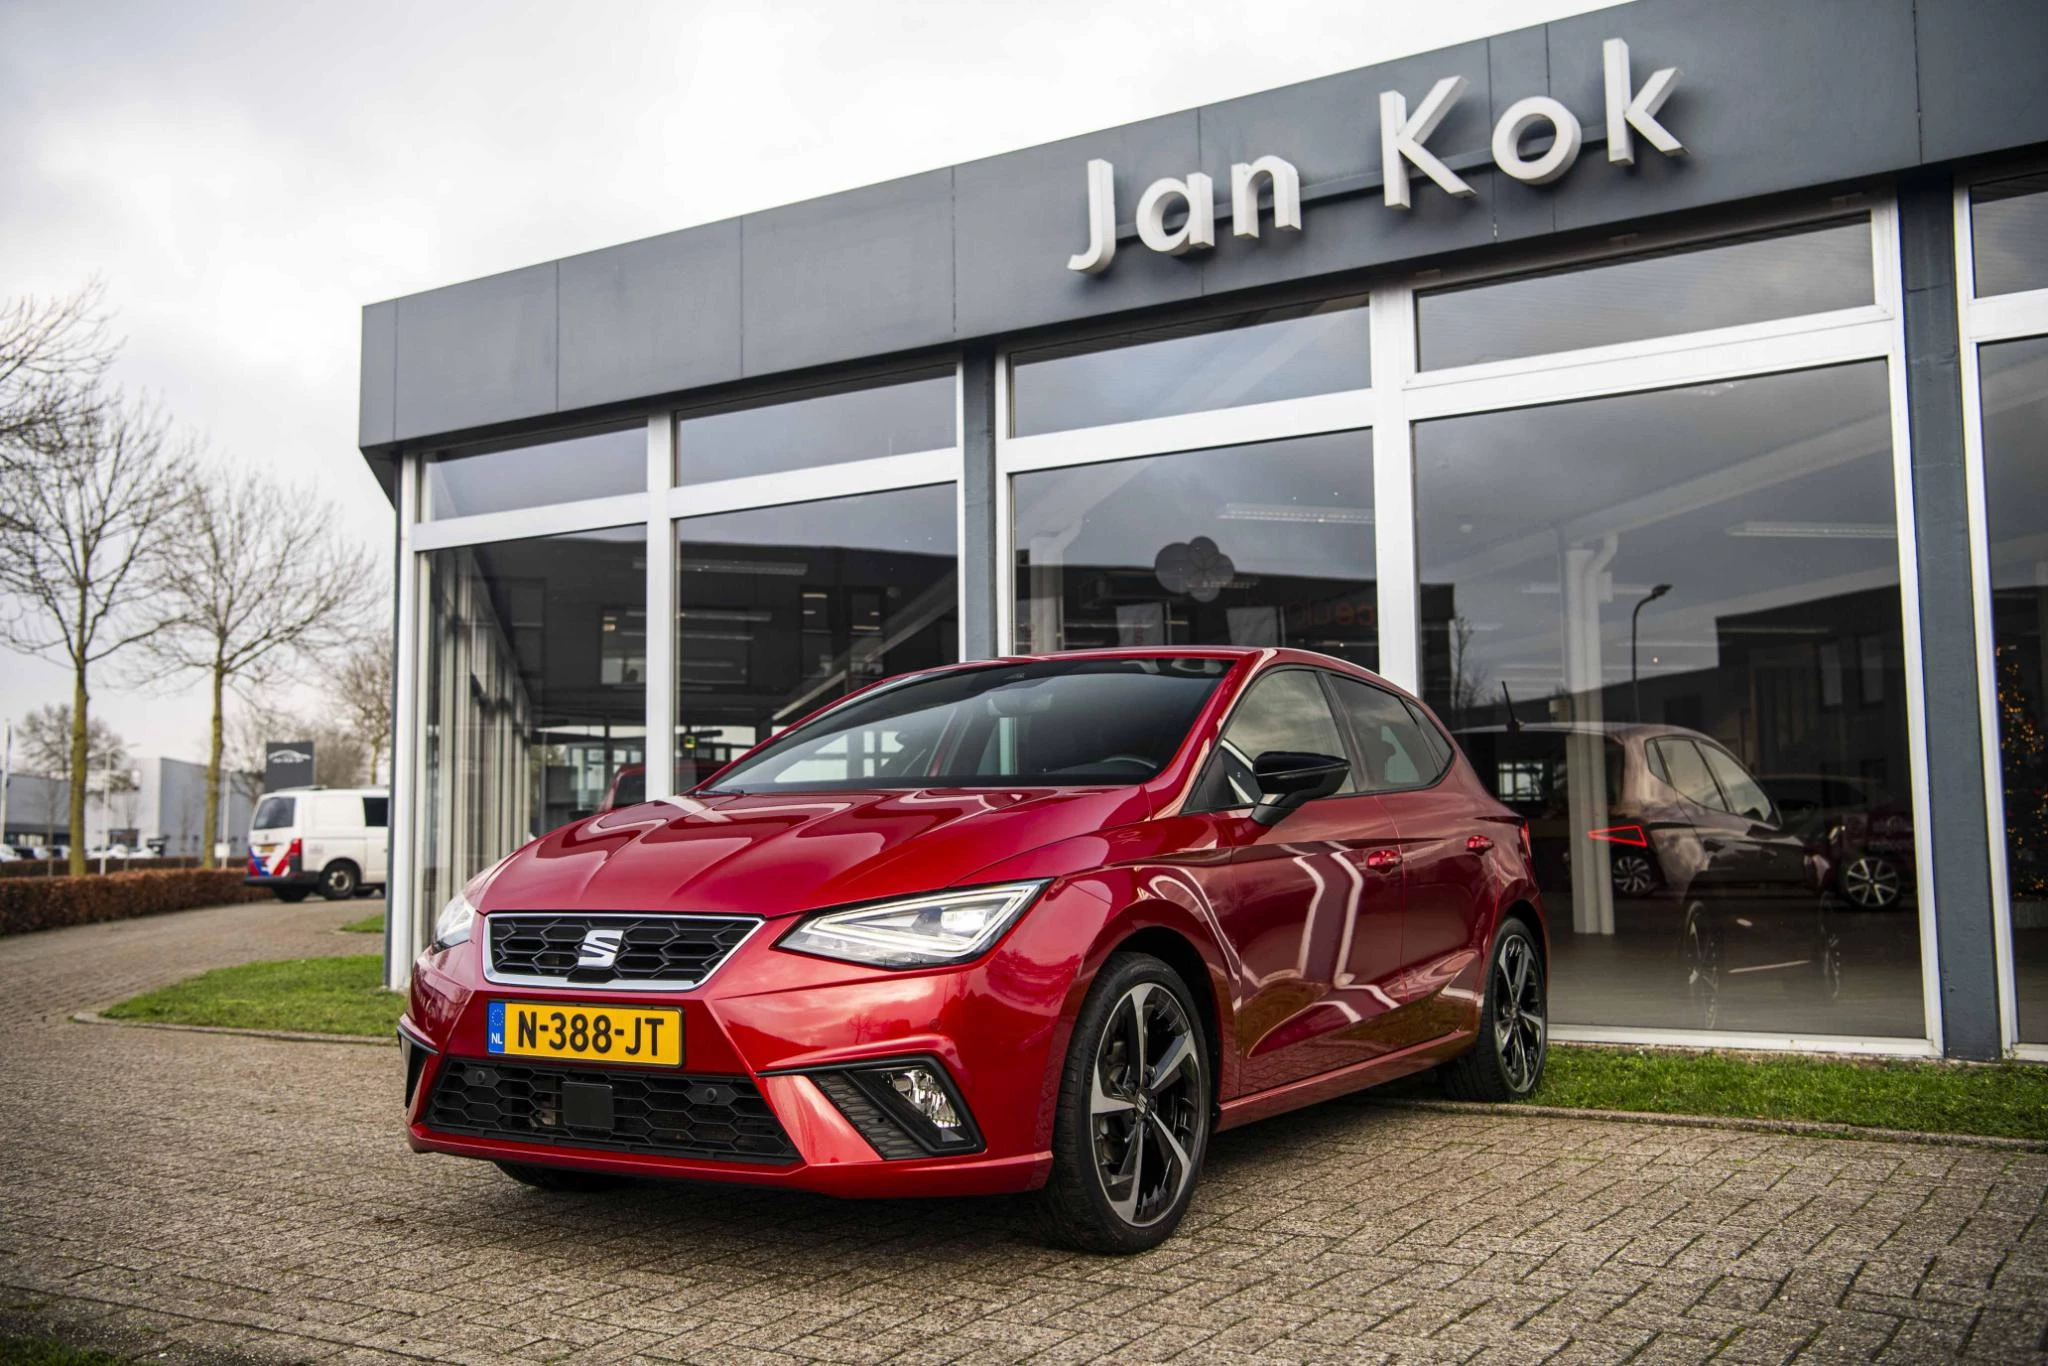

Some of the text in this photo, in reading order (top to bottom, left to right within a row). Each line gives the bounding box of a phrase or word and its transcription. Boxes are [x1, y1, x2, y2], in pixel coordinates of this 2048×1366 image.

[1067, 37, 1690, 273] Jan Kok
[491, 1032, 503, 1045] NL
[518, 1010, 665, 1056] N-388-JT
